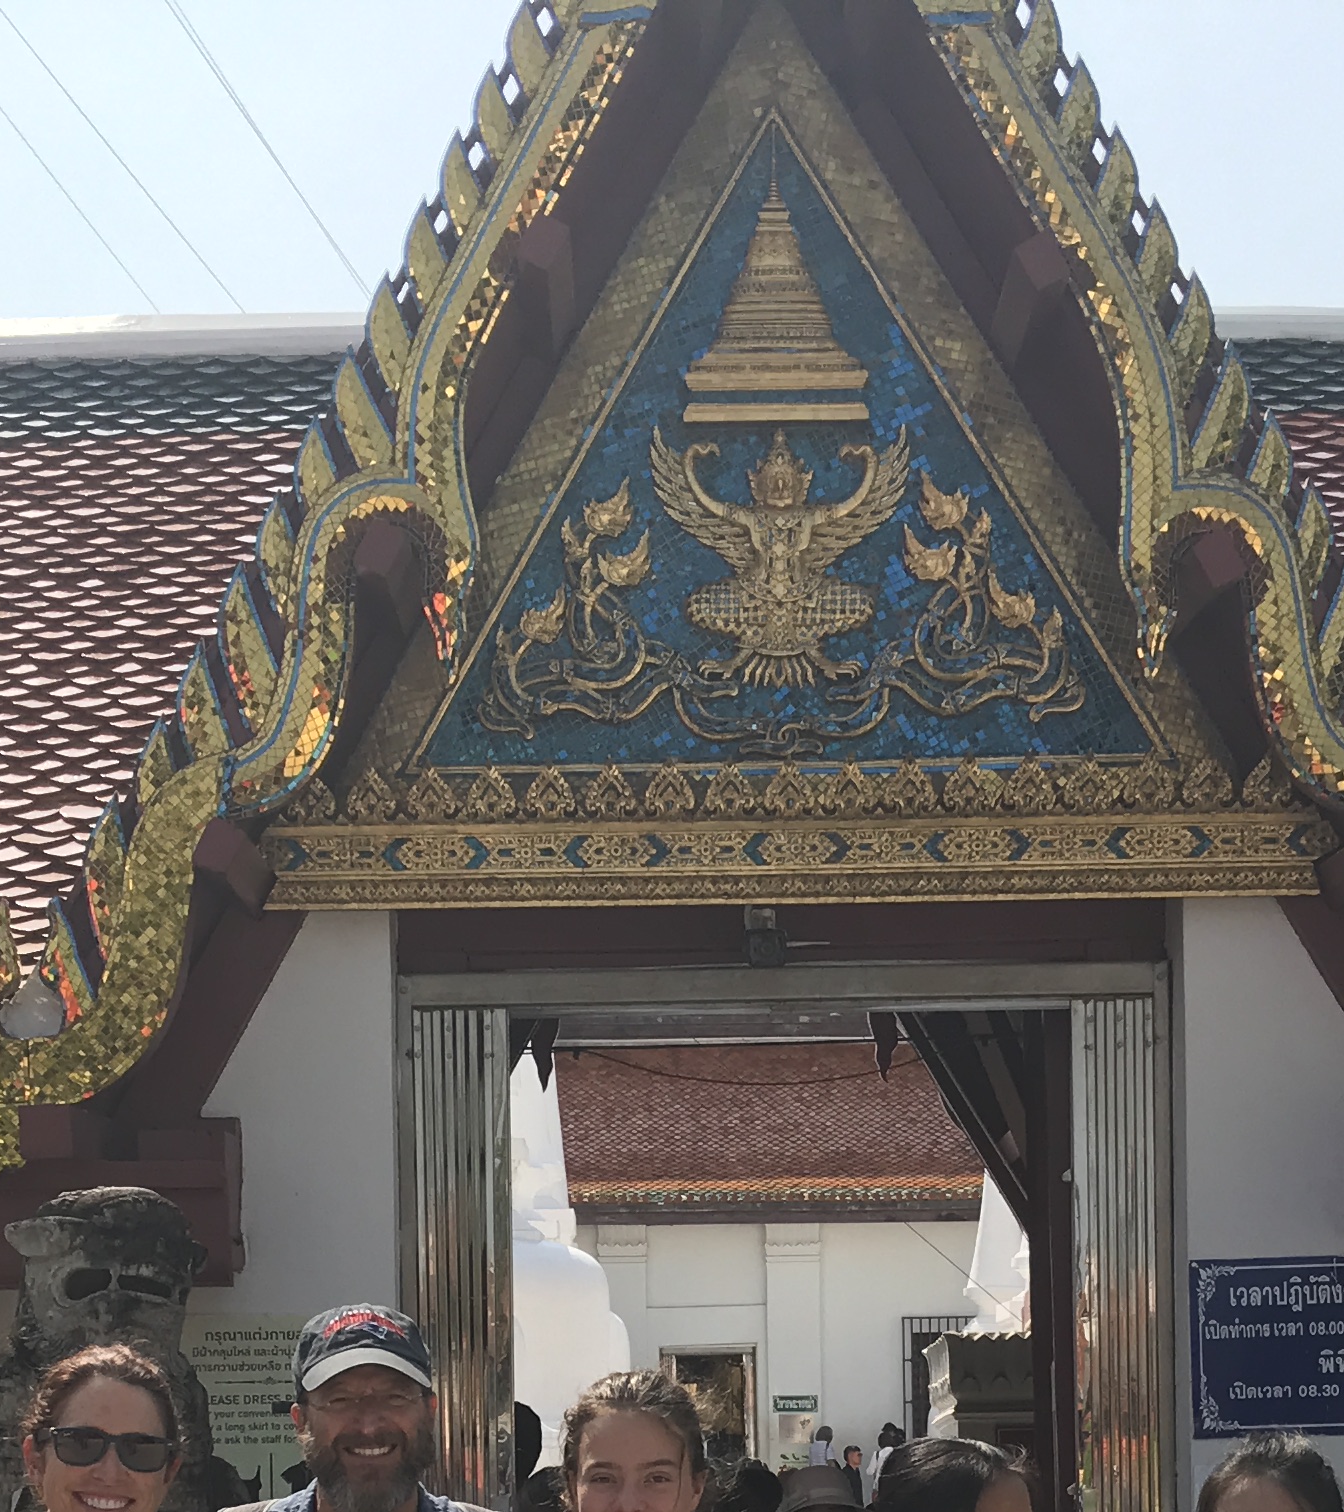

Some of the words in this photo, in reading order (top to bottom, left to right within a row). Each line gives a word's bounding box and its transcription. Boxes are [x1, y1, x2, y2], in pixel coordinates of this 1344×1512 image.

[1206, 1318, 1270, 1340] เปิดทำการ
[1274, 1321, 1304, 1337] เวลา
[1308, 1320, 1344, 1335] 08.00
[1229, 1381, 1292, 1400] เปิดเวลา
[1298, 1384, 1340, 1397] 08.30
[208, 1395, 240, 1405] EASE
[214, 1410, 234, 1420] your
[224, 1422, 246, 1433] long
[248, 1422, 269, 1431] skirt
[271, 1422, 281, 1431] to
[225, 1436, 240, 1444] ask
[243, 1435, 257, 1444] the
[261, 1435, 281, 1444] staff
